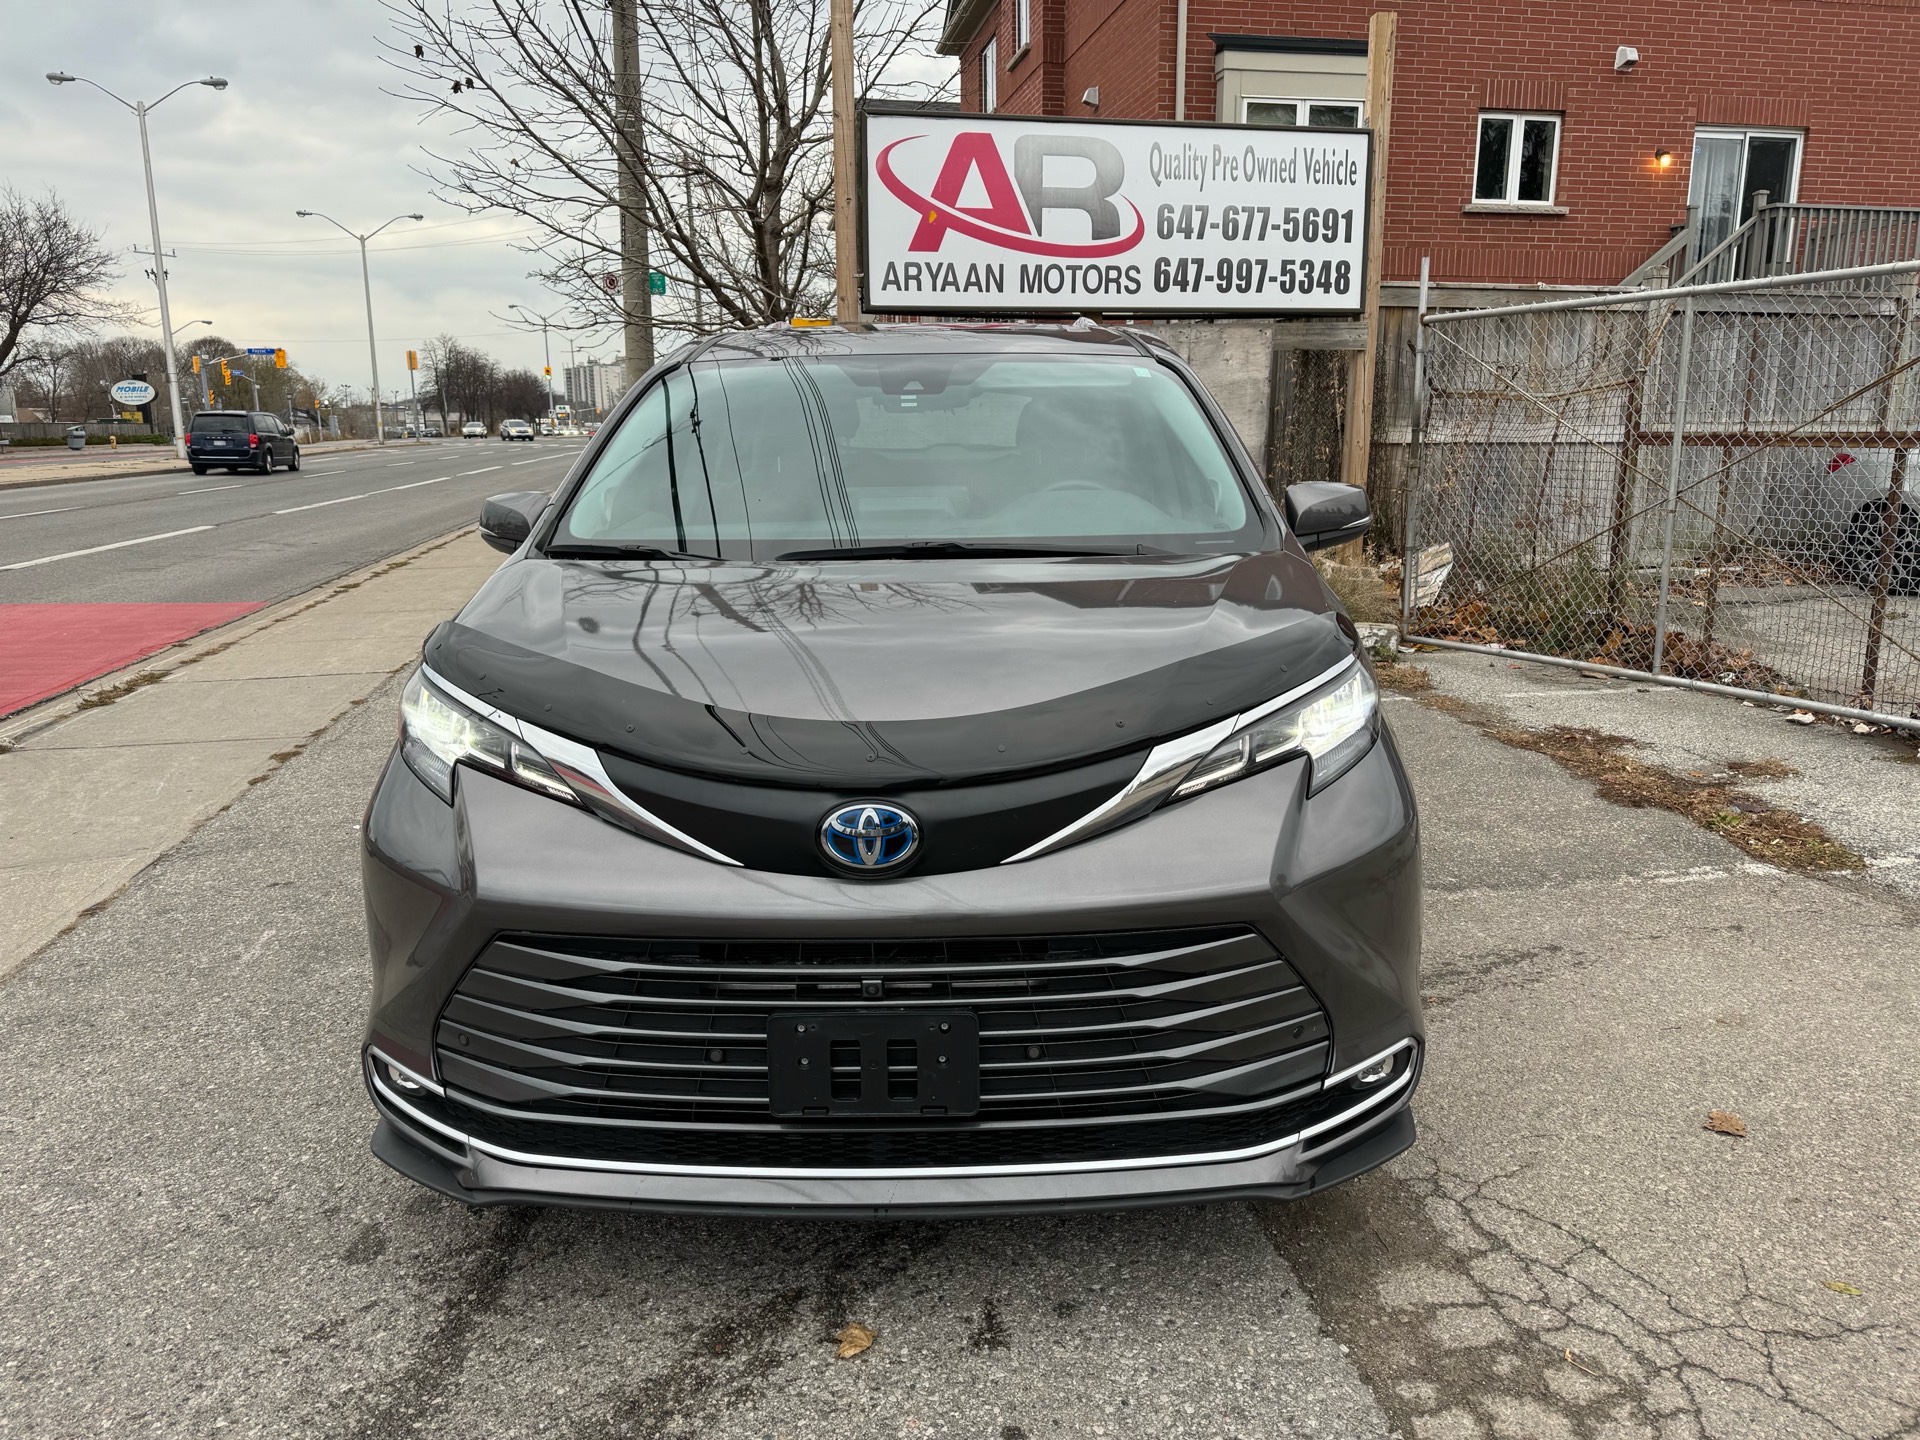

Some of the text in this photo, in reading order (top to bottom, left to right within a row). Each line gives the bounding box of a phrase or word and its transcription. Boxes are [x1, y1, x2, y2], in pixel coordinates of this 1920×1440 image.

[1149, 141, 1357, 192] Quality Pre Owned Vehicle
[1156, 203, 1353, 244] 647-677-5691
[881, 261, 1142, 295] ARYAAN MOTORS
[1154, 257, 1351, 295] 647-997-5348
